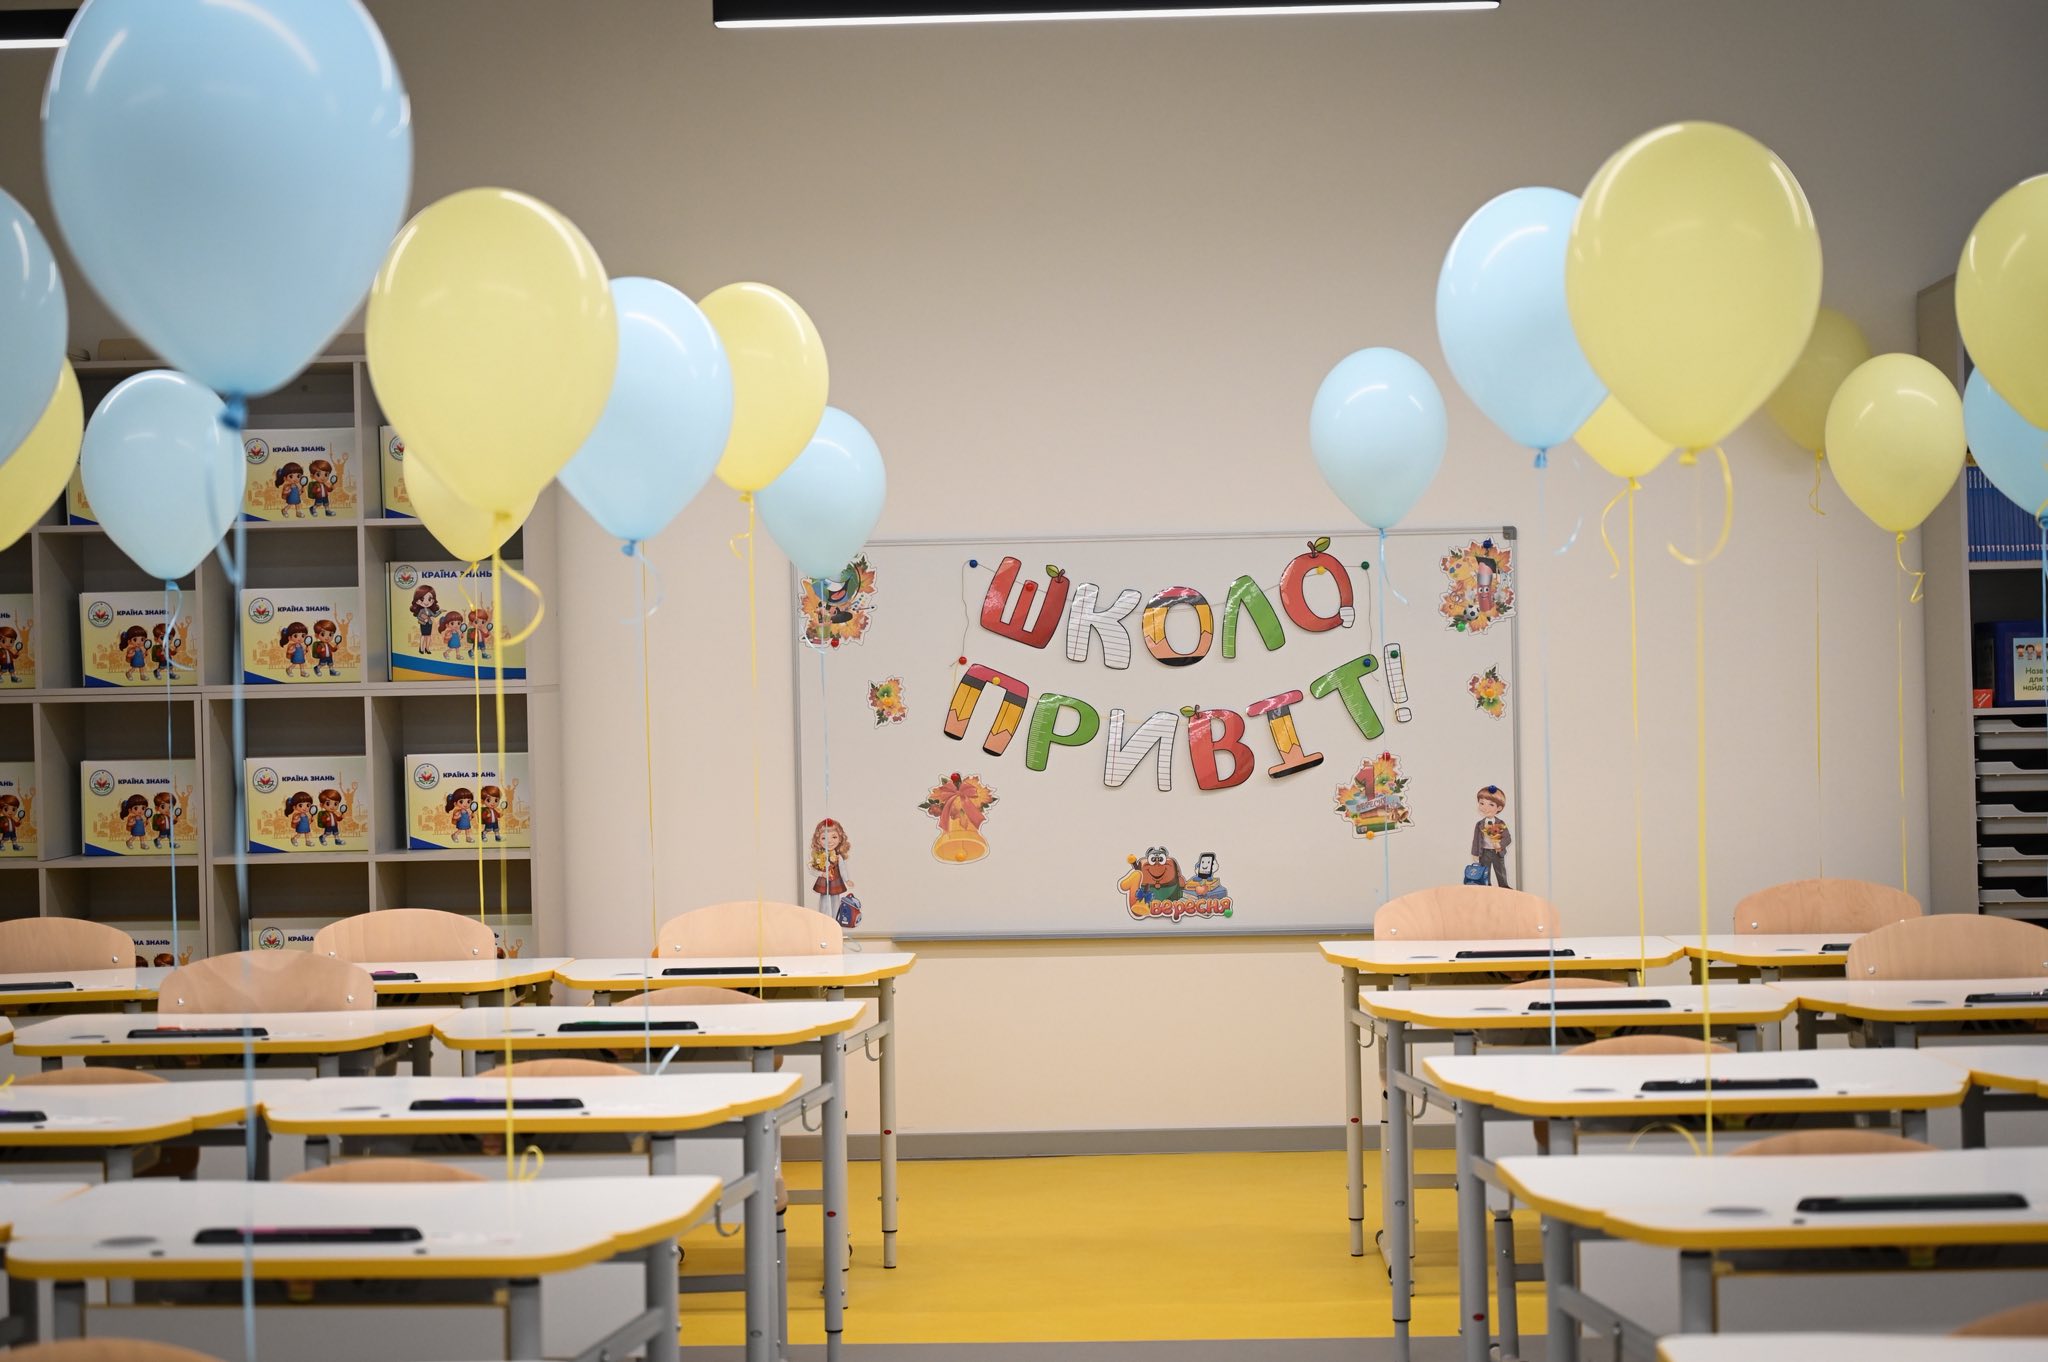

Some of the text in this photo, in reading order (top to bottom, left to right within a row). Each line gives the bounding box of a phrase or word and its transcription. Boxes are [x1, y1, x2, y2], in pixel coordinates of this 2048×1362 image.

[272, 445, 299, 453] КРАЇНА
[421, 569, 457, 578] КРАЇНА
[117, 608, 143, 616] КРАЇНА
[277, 605, 304, 613] КРАЇНА
[281, 774, 308, 782] КРАЇНА
[442, 770, 470, 778] КРАЇНА
[118, 777, 144, 785] КРАЇНА
[1149, 898, 1232, 920] вересня
